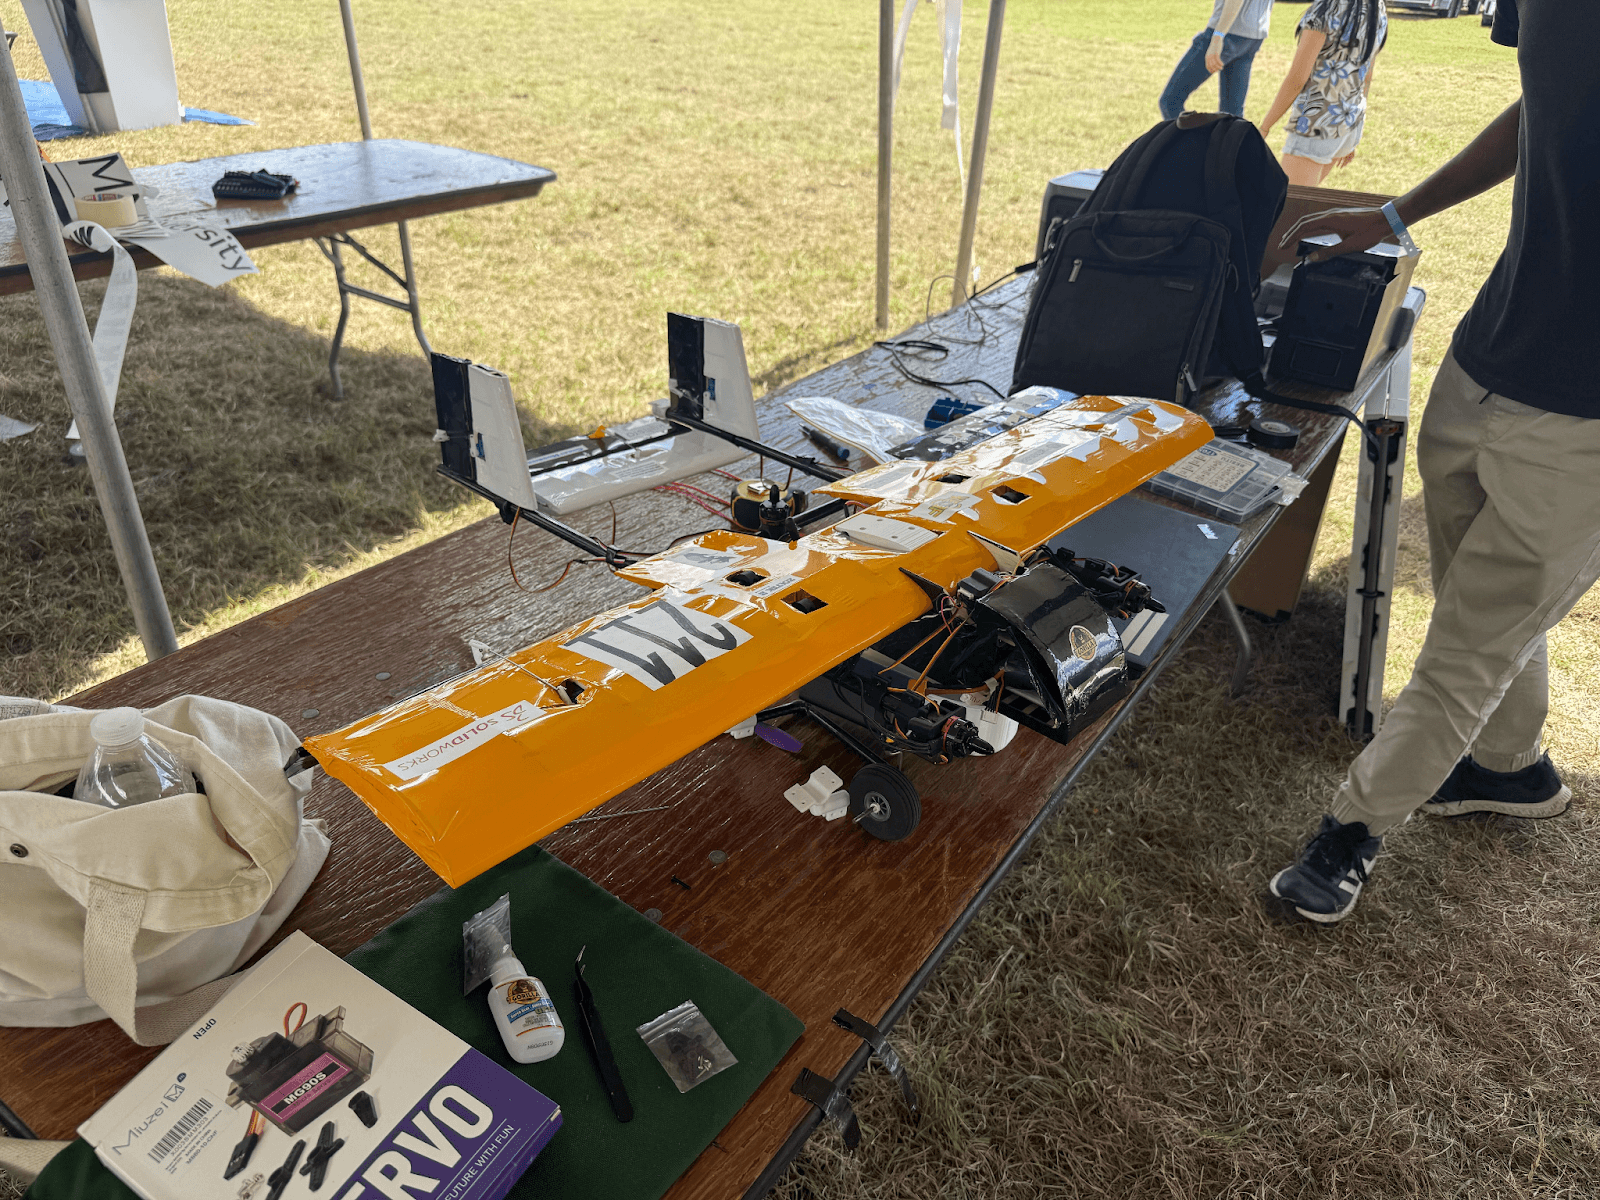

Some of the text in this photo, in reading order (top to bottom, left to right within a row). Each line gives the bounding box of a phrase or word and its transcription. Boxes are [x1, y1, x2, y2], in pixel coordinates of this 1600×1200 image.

[563, 600, 738, 685] 211
[397, 718, 499, 772] SOLIDWORKS
[512, 992, 540, 1001] GORILLA
[193, 1018, 217, 1040] OPEN
[283, 1071, 327, 1105] MG90S
[112, 1101, 169, 1155] Miuzei
[475, 1146, 499, 1168] WITH
[494, 1124, 515, 1146] FUN
